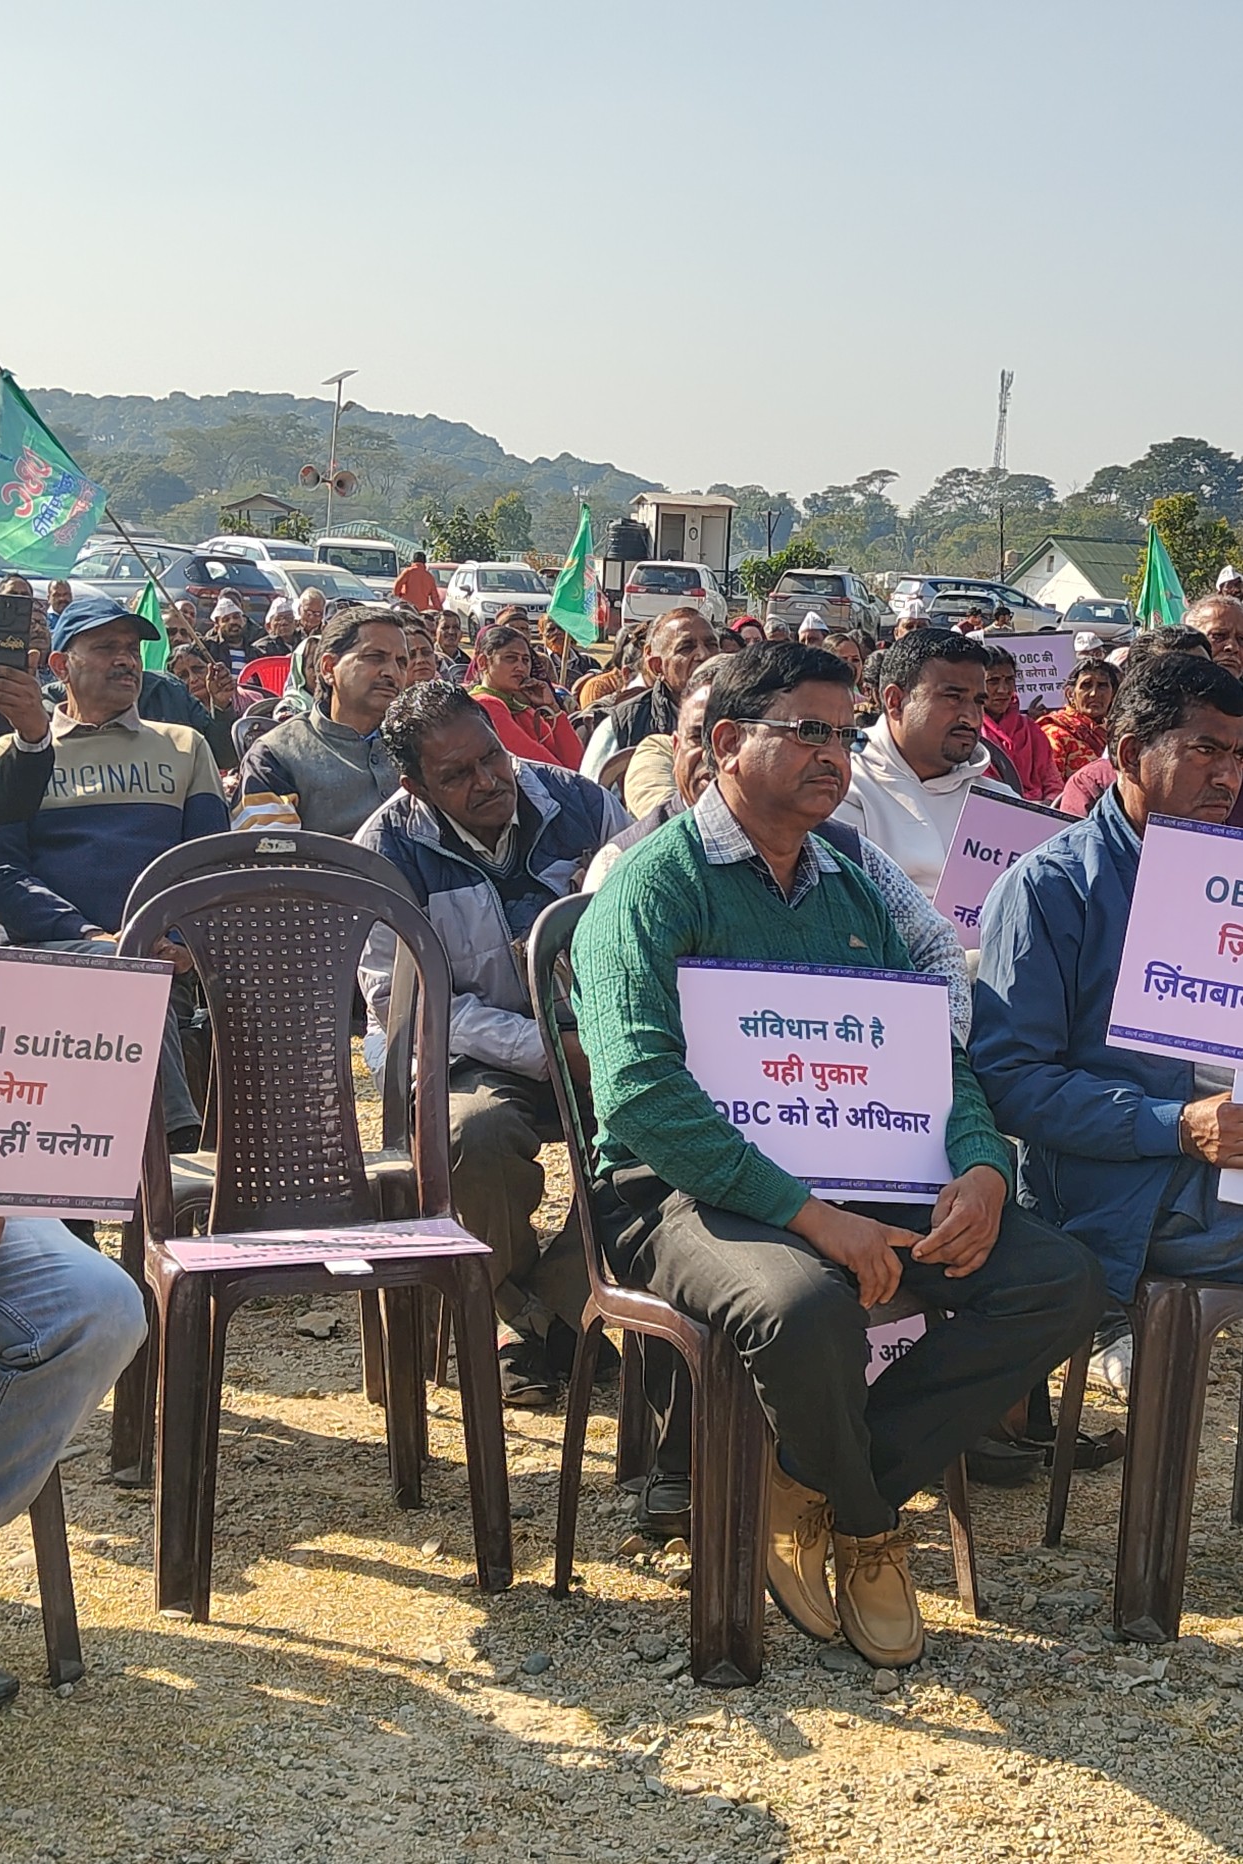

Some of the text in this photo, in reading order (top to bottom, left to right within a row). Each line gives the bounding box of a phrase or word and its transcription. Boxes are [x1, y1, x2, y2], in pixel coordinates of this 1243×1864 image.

[1019, 653, 1040, 664] OBC
[44, 761, 175, 798] RIGINALS
[963, 838, 1003, 865] Not
[1144, 961, 1243, 1008] ज़िंदाबा
[14, 1030, 143, 1064] suitable
[739, 1009, 885, 1049] संविधान की है
[762, 1053, 868, 1091] यही पुकार
[778, 1096, 809, 1126] को
[815, 1098, 839, 1129] दो
[845, 1101, 931, 1134] अधिकार
[36, 1123, 114, 1158] चलेगा
